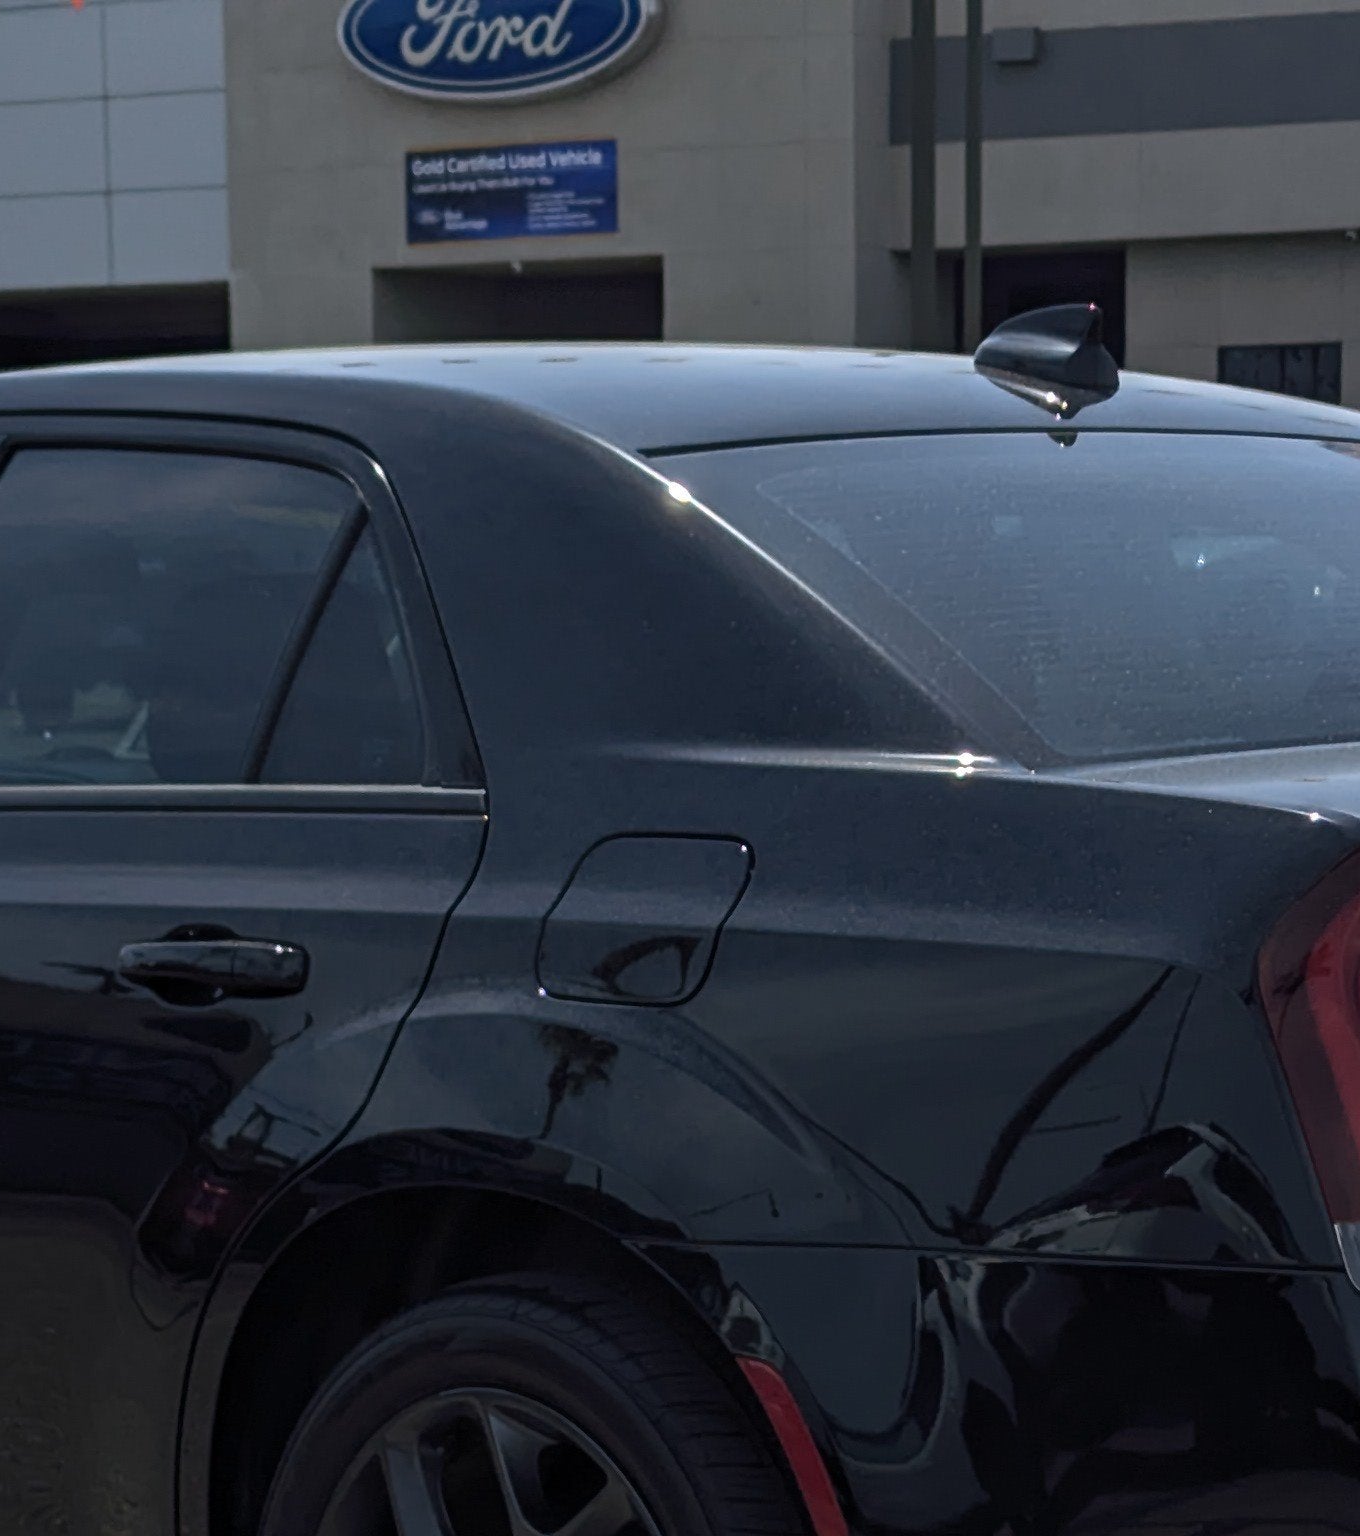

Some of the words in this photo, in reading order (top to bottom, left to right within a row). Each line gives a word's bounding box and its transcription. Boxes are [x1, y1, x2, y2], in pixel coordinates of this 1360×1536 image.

[400, 0, 573, 67] Ford
[411, 159, 445, 176] Gold
[446, 154, 507, 174] Certified
[508, 151, 546, 169] Used
[548, 148, 603, 167] Vehicle
